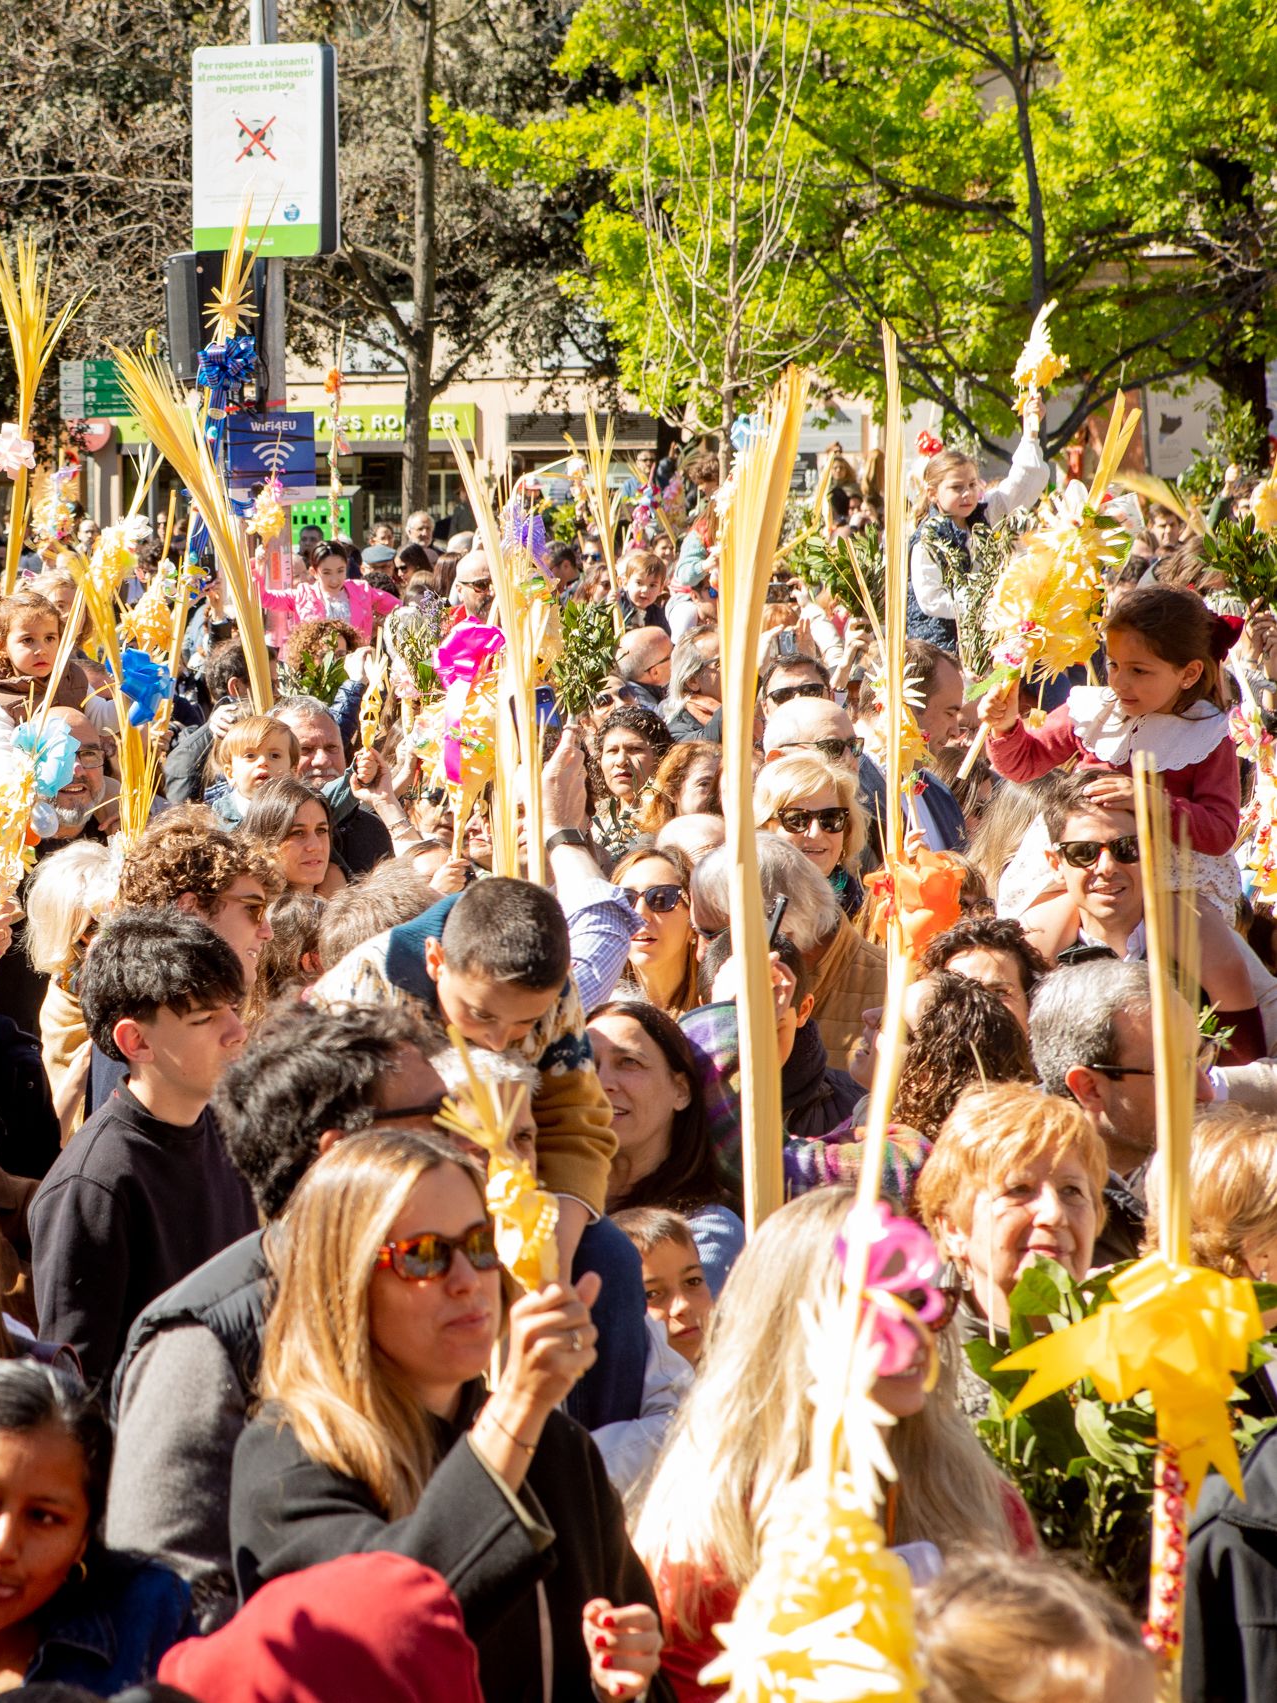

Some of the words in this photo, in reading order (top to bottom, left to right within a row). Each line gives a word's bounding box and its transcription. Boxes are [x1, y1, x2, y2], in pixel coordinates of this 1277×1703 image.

[198, 62, 212, 70] Per
[215, 60, 253, 71] respecte
[255, 58, 268, 68] als
[270, 57, 309, 67] vianants
[197, 73, 206, 82] al
[207, 71, 257, 82] monument
[258, 70, 273, 80] del
[274, 68, 314, 79] Monestir
[216, 85, 227, 93] no
[228, 83, 260, 94] jugueu
[269, 81, 296, 92] pilota
[250, 420, 297, 431] WiFi4EU
[371, 413, 457, 430] ROER
